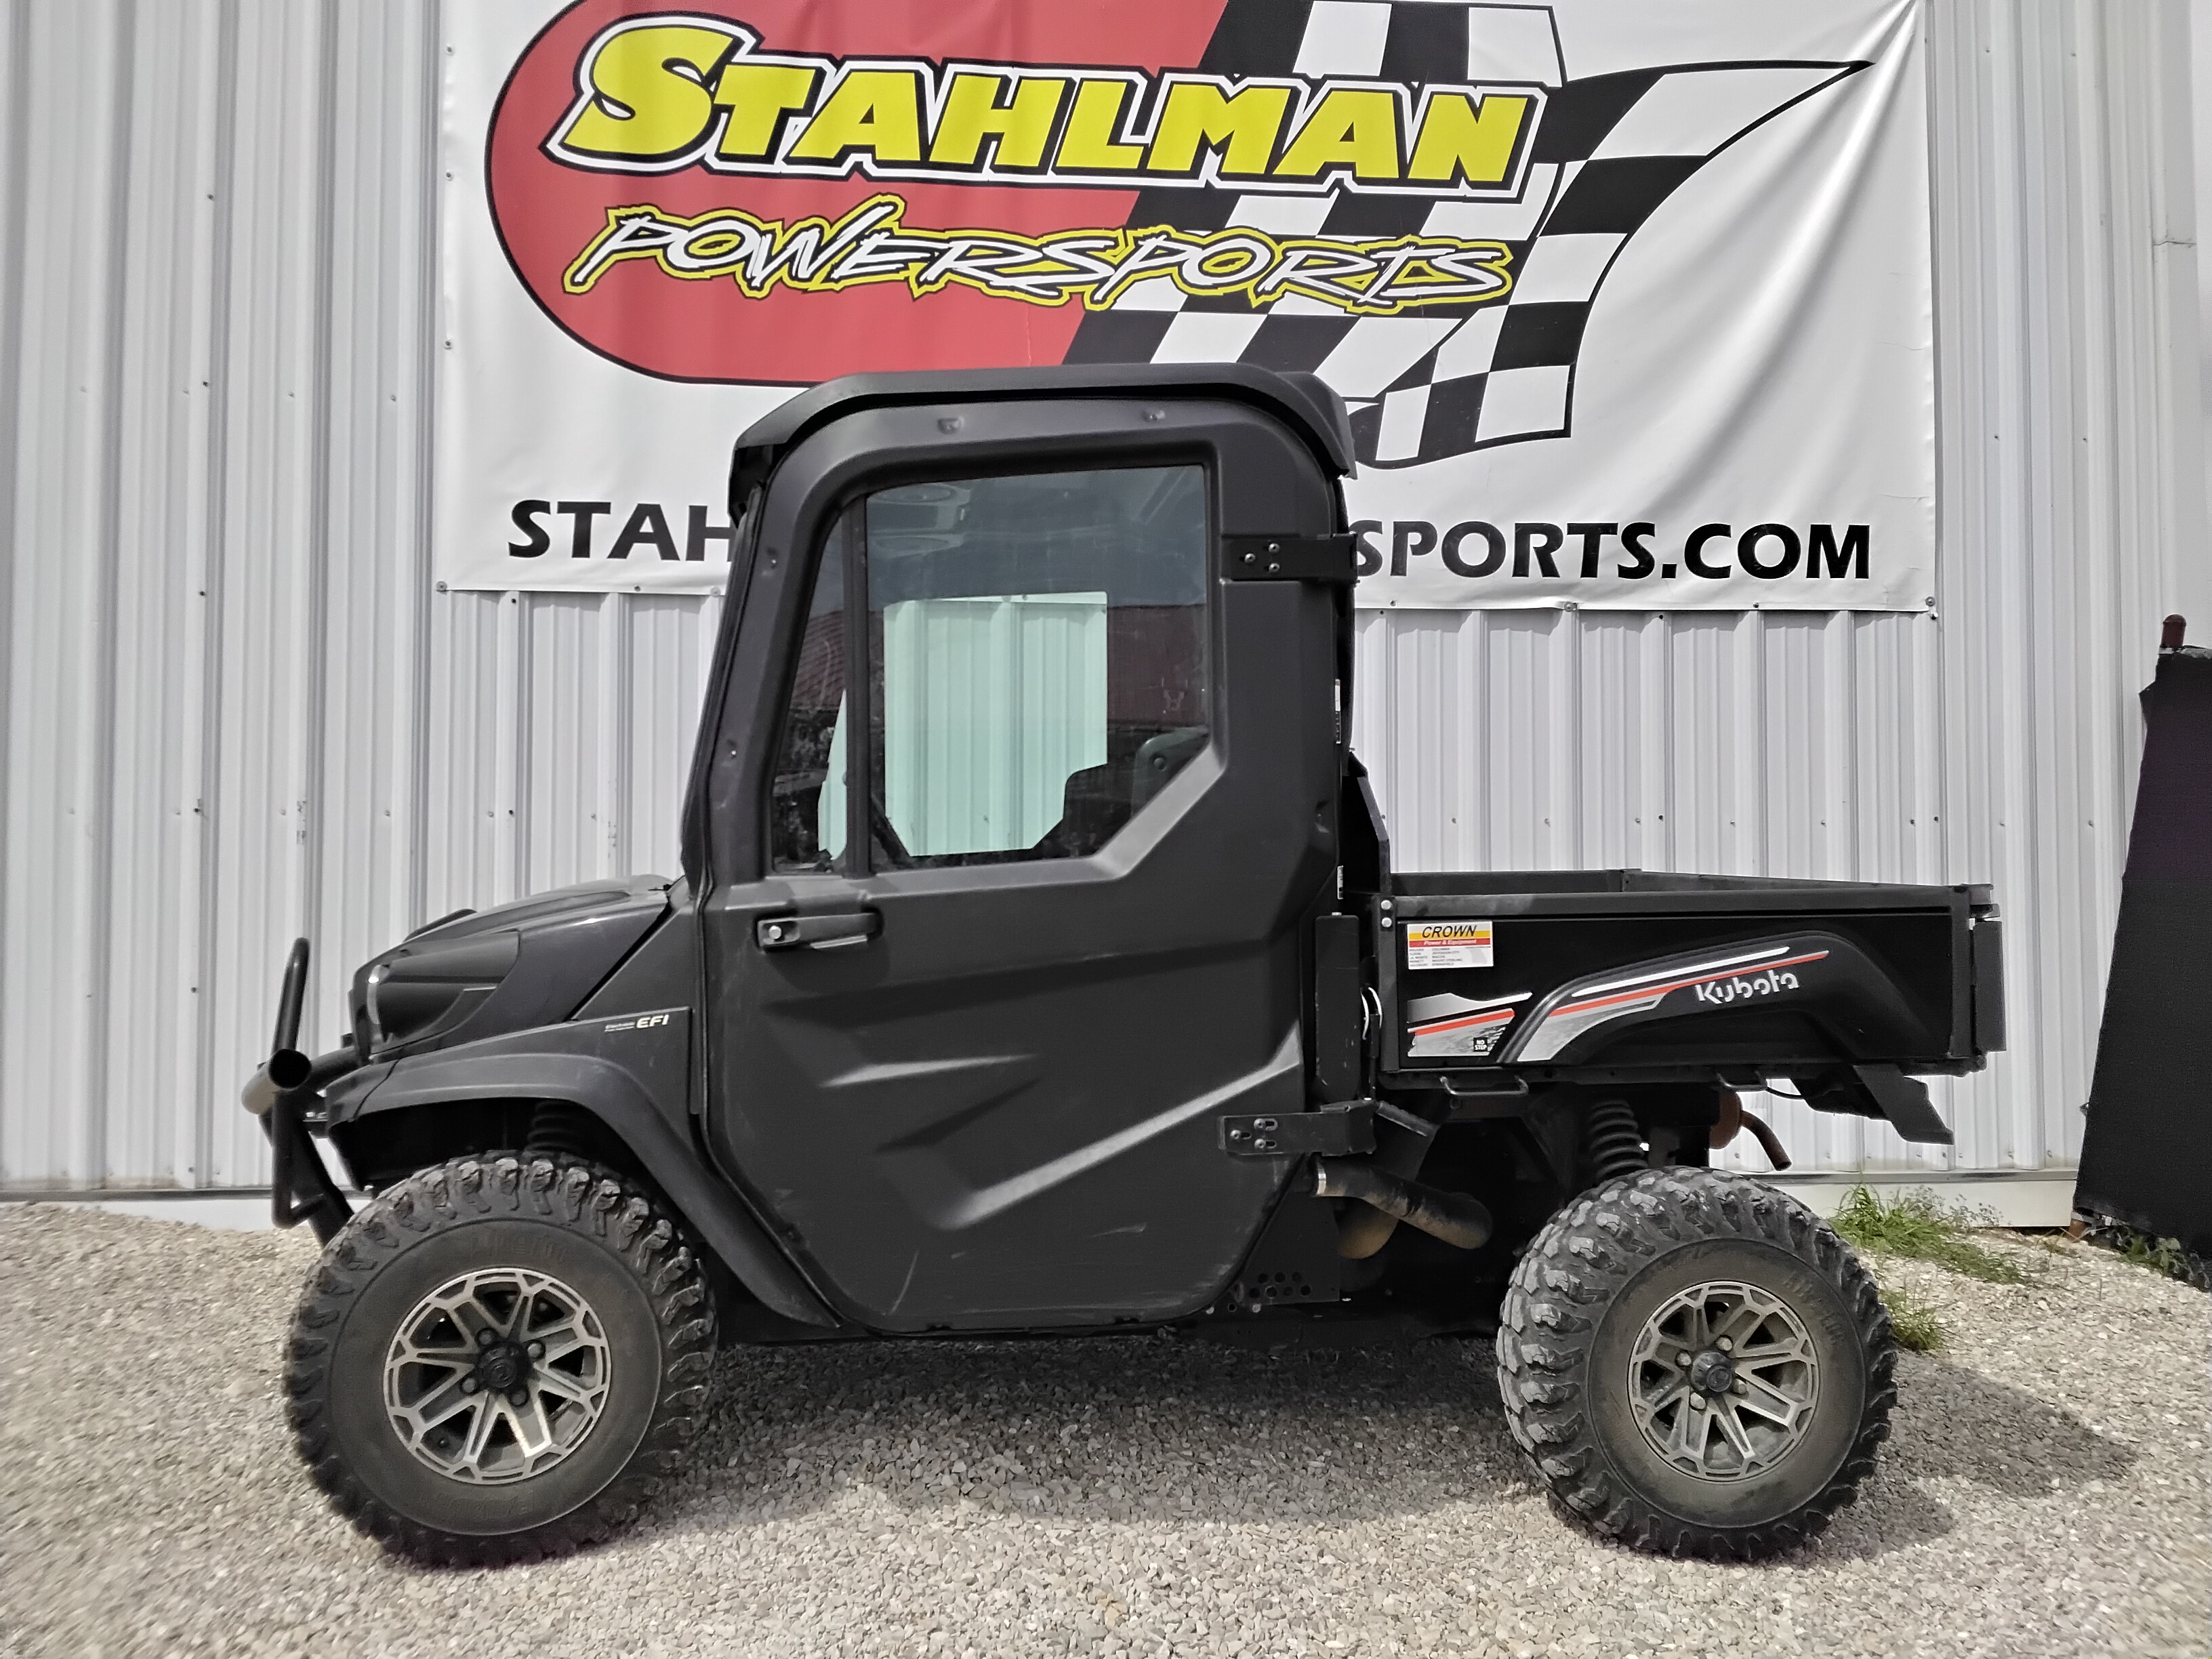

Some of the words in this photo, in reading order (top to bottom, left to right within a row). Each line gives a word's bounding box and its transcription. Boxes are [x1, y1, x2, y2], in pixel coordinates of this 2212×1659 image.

[548, 18, 1540, 192] STAHLMAN
[568, 197, 1510, 310] POWERSPORTS
[1422, 924, 1477, 938] CROWN
[1695, 969, 1799, 1004] Kubota
[636, 1014, 670, 1029] EFI
